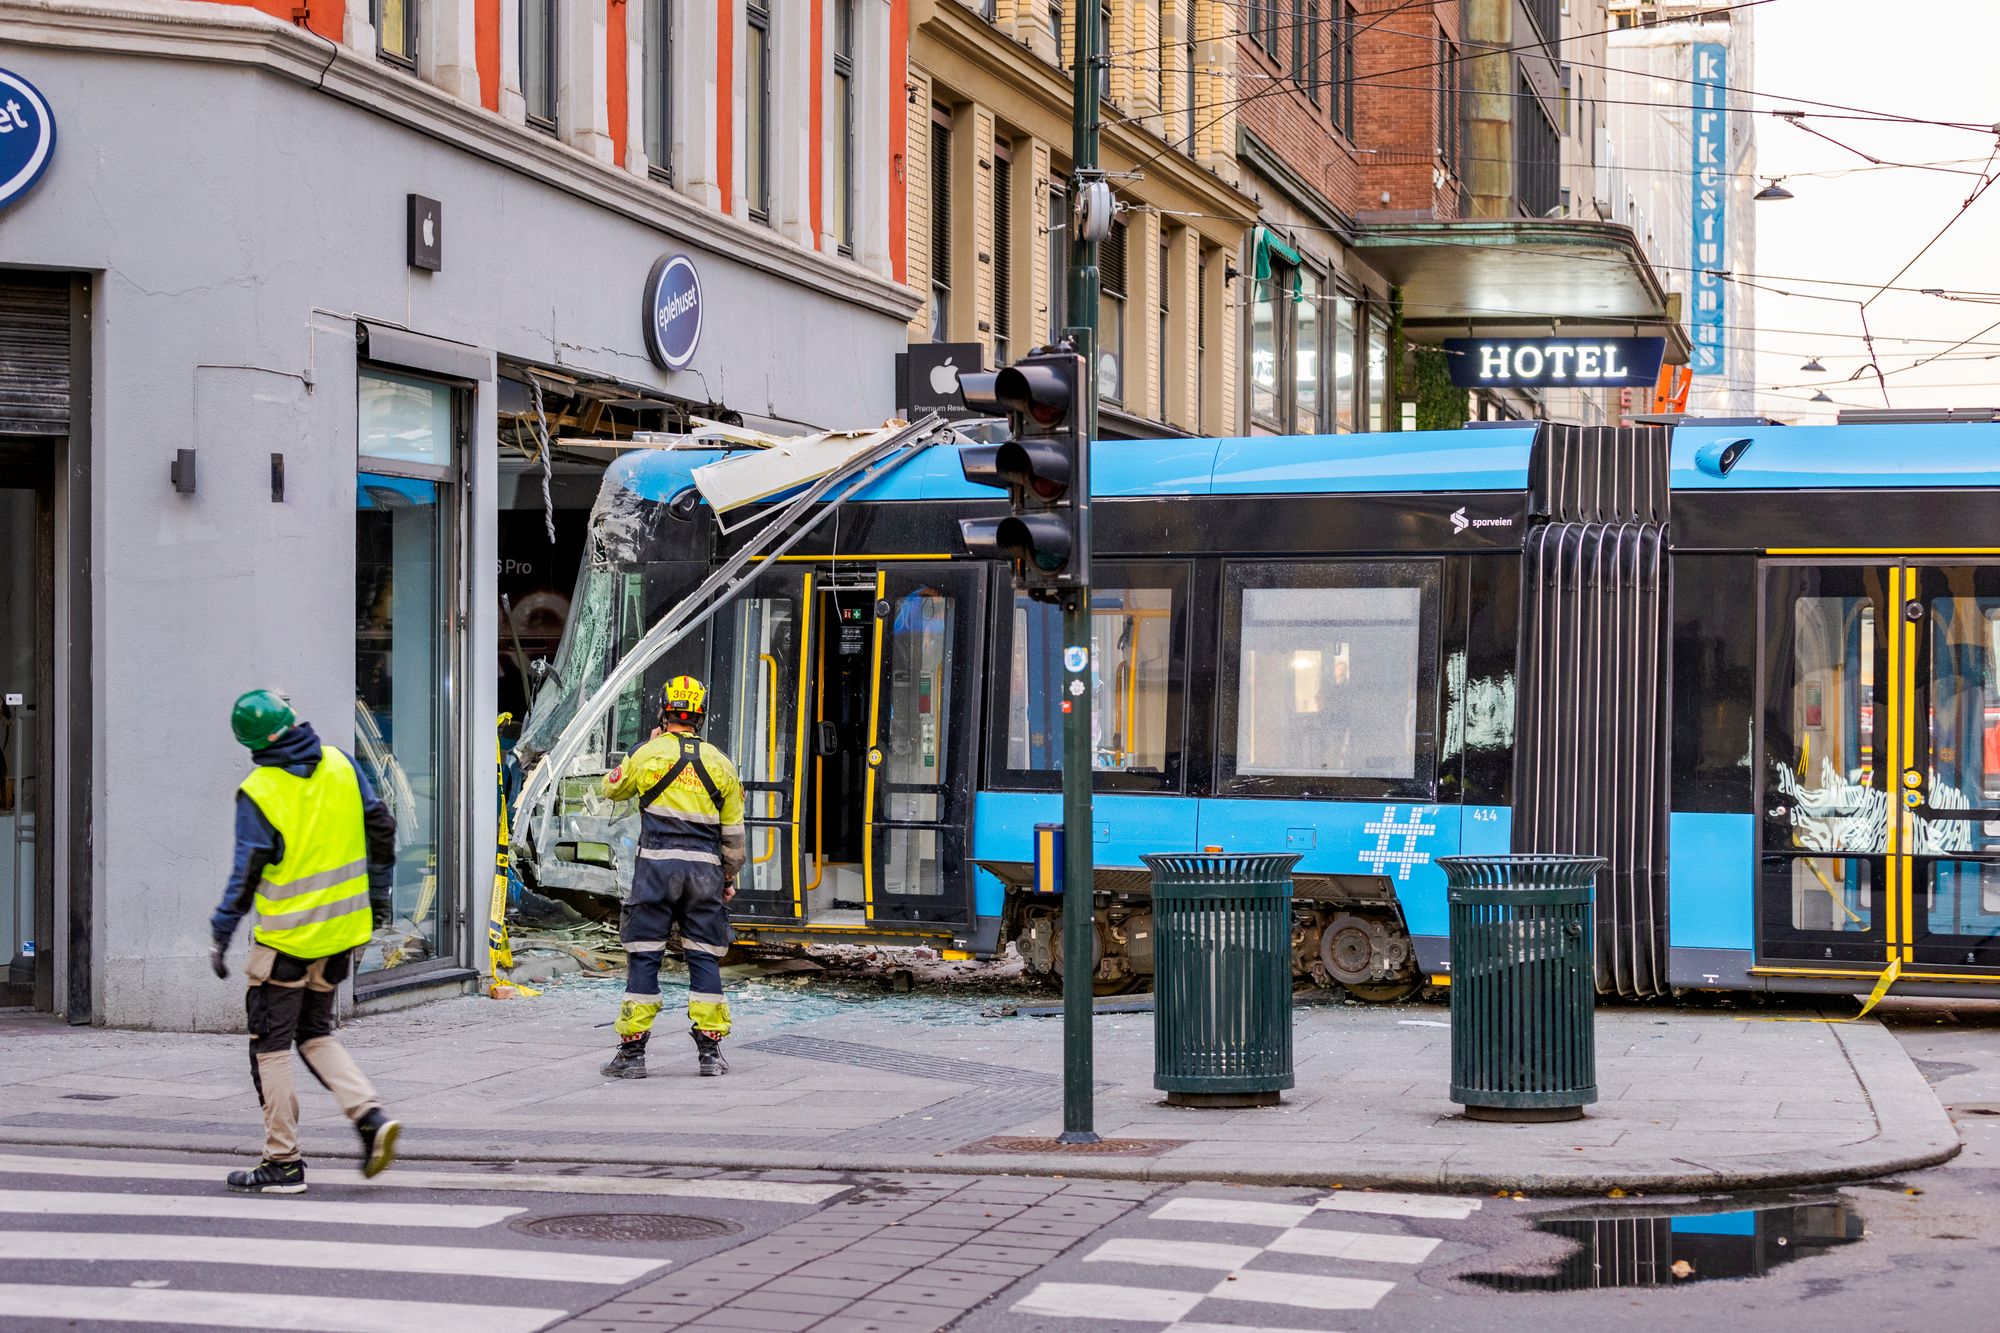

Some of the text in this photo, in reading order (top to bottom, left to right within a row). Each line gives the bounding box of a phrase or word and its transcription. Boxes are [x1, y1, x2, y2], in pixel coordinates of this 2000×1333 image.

[1698, 51, 1720, 311] kirkestuen
[658, 283, 698, 332] eplehuset
[1479, 346, 1628, 378] HOTEL
[914, 404, 968, 412] Premium Rese
[1472, 516, 1513, 529] sporveien
[505, 559, 532, 575] Pro
[673, 689, 699, 701] 3672
[1473, 808, 1498, 821] 414
